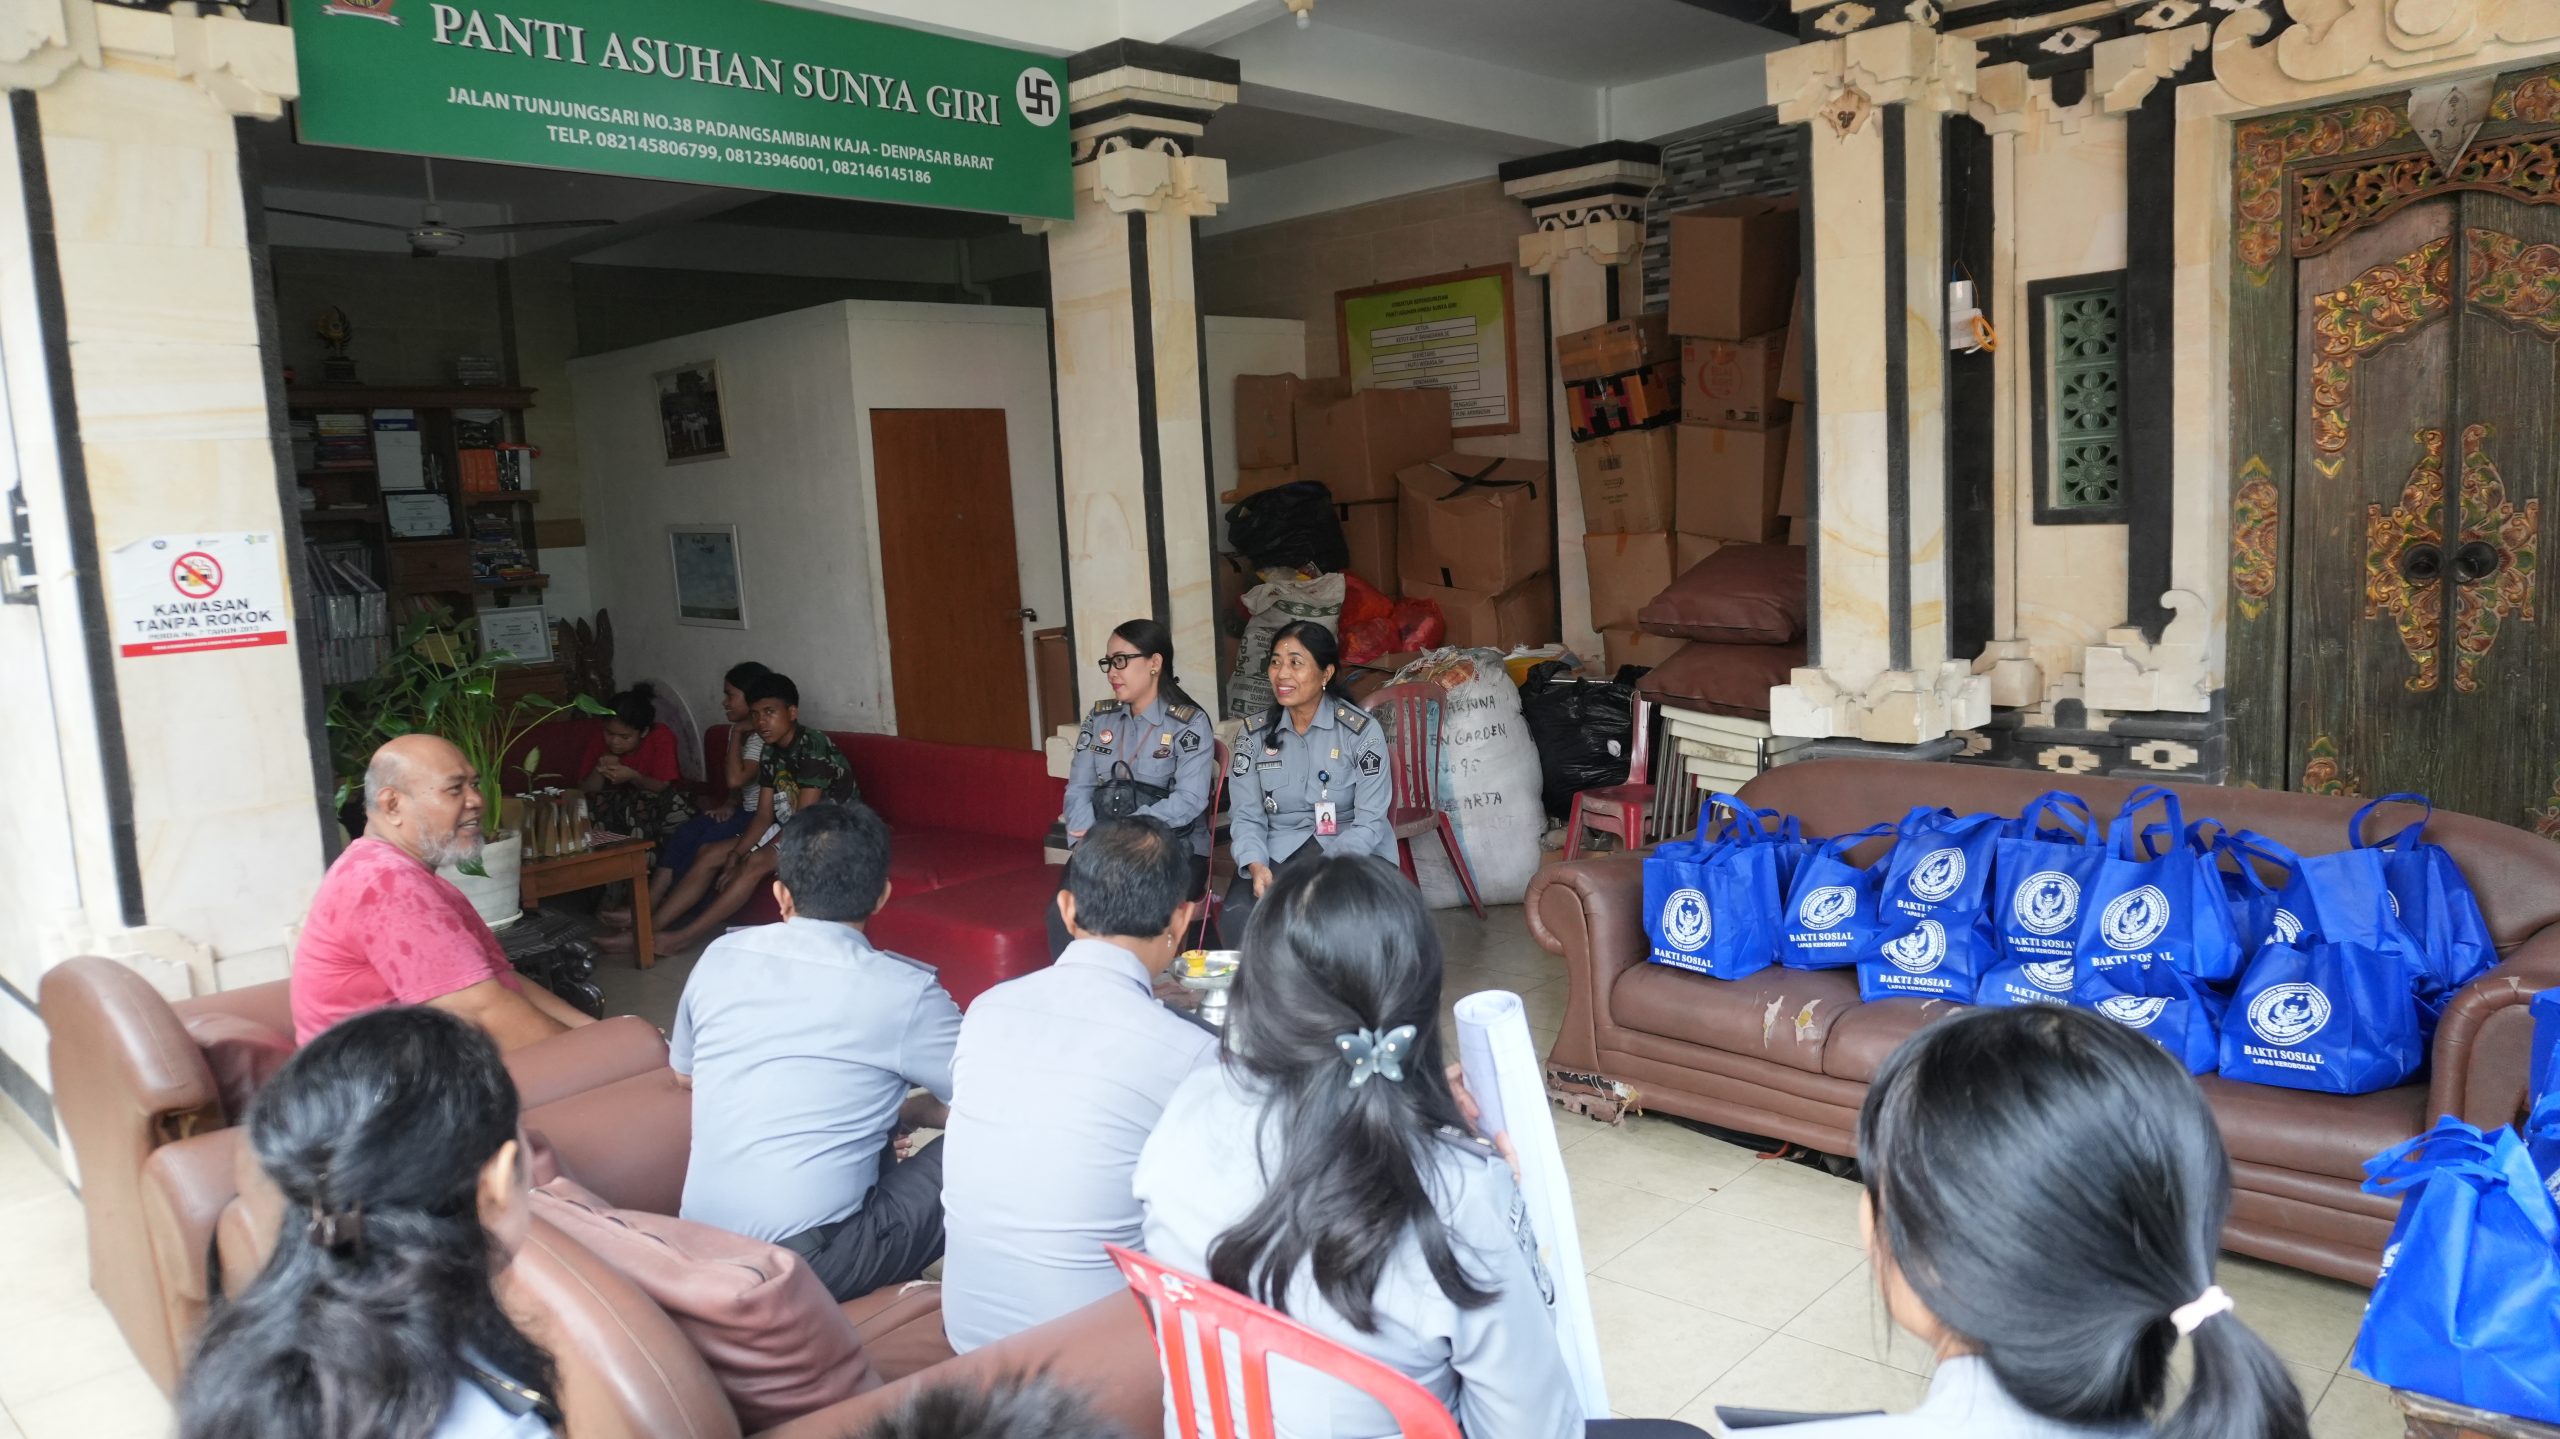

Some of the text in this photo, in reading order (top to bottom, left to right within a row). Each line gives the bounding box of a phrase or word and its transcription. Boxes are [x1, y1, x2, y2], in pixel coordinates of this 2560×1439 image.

[430, 3, 1002, 126] PANTI ASUHAN SUNYA GIRI
[447, 86, 509, 111] JALAN
[513, 95, 639, 127] TUNJUNGSARI
[643, 112, 692, 134] NO.38
[696, 119, 831, 150] PADANGSAMBIAN
[834, 137, 870, 155] KAJA
[880, 143, 952, 165] DENPASAR
[954, 153, 994, 171] BARAT
[546, 125, 932, 184] TELP. 082145806799, 08123946001, 082146145186
[153, 598, 248, 617] KAWASAN
[134, 610, 272, 633] TANPA ROKOK
[1897, 899, 1926, 912] BAKTI
[1789, 931, 1854, 942] BAKTI SOSIAL
[2007, 935, 2040, 946] BAKTI
[1654, 947, 1714, 968] BAKTI SOSIAL
[2016, 946, 2072, 956] LAPAS KEROBOKAN
[2090, 955, 2128, 966] BAKTI
[1880, 974, 1952, 988] BAKTI SOSIAL
[1906, 985, 1944, 994] KEROBOKAN
[2005, 983, 2042, 1001] BAKTI
[2243, 1044, 2325, 1065] BAKTI SOSIAL
[2252, 1057, 2317, 1071] LAPAS KEROBOKAN
